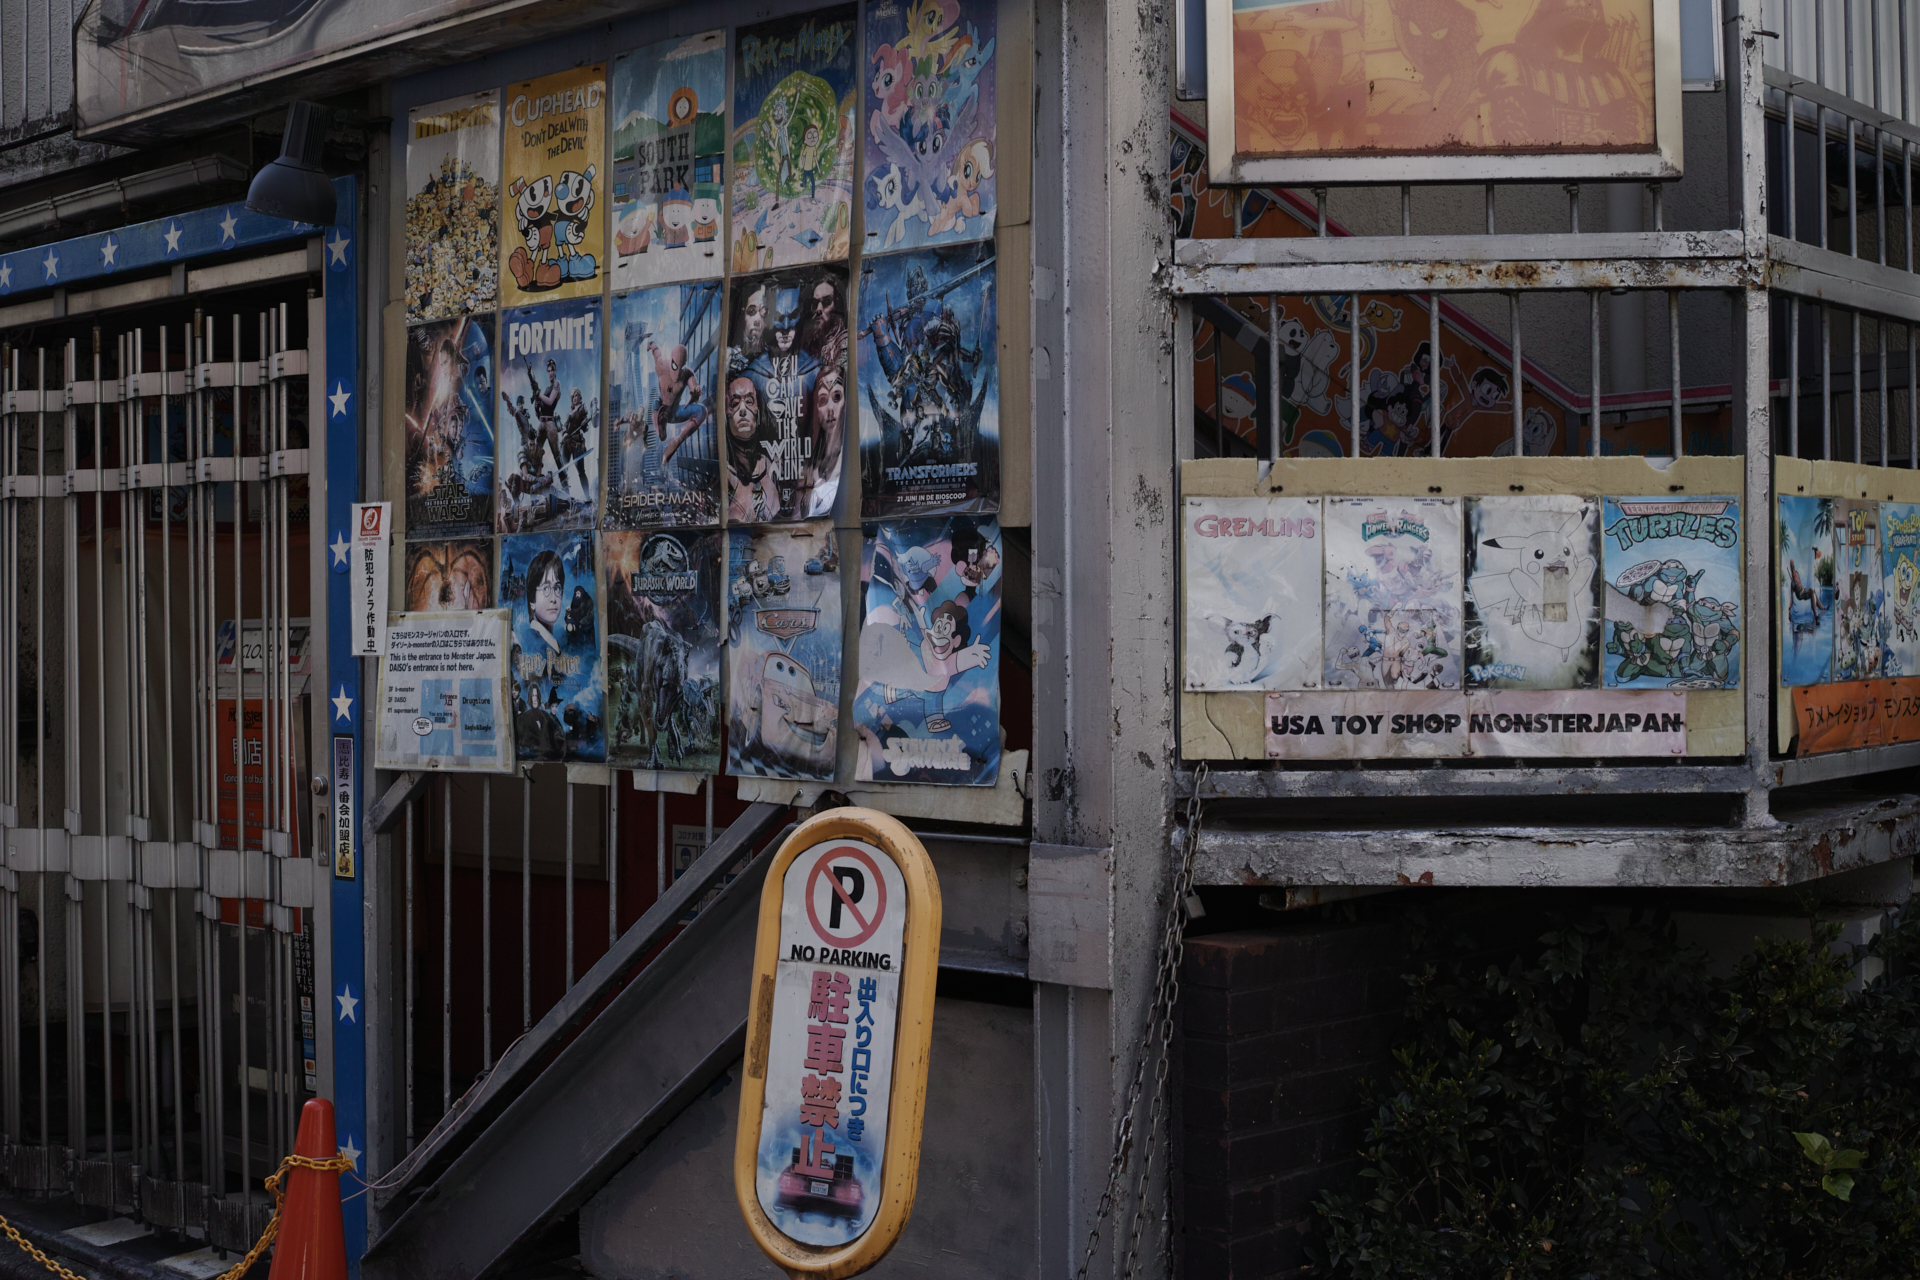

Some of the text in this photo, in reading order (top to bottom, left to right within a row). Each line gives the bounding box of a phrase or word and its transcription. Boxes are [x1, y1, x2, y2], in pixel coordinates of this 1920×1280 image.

[796, 17, 851, 62] Morty
[511, 84, 600, 127] CUPHEAD
[548, 120, 568, 140] DEAL
[568, 116, 588, 132] WITH
[547, 145, 560, 160] THE
[639, 132, 689, 168] SOUTH
[640, 165, 689, 195] PARK
[509, 312, 594, 360] FORTNITE
[759, 437, 811, 460] WORLD
[885, 462, 978, 480] TRANSFORMERS
[427, 484, 470, 501] STAR
[624, 491, 703, 508] SPIDER-MAN
[427, 504, 470, 522] WARS
[1624, 504, 1724, 514] TEENAGE MUTANT NINJA
[1848, 509, 1868, 533] TOY
[1397, 518, 1428, 539] RANGERS
[1605, 511, 1738, 551] TURTLES
[633, 576, 696, 592] JURASSIC WORLD
[365, 548, 375, 651] 防犯カメラ作動中
[761, 612, 809, 629] Cars
[389, 663, 411, 672] DAISO's
[413, 664, 439, 672] entrance
[440, 663, 445, 671] is
[458, 662, 475, 671] here.
[390, 653, 401, 661] This
[407, 653, 417, 661] the
[451, 652, 475, 660] Monster
[476, 652, 496, 662] Japan.
[519, 647, 580, 681] Harry Potter
[462, 697, 490, 706] Drugstore
[1805, 697, 1877, 729] アメトイショップ
[1271, 713, 1681, 735] USA TOY SHOP MONSTERJAPAN
[338, 742, 350, 854] 恵比寿一番会加盟店
[791, 944, 891, 970] NO PARKING
[847, 976, 877, 1141] 出入り口につき
[794, 970, 851, 1180] 駐車禁止
